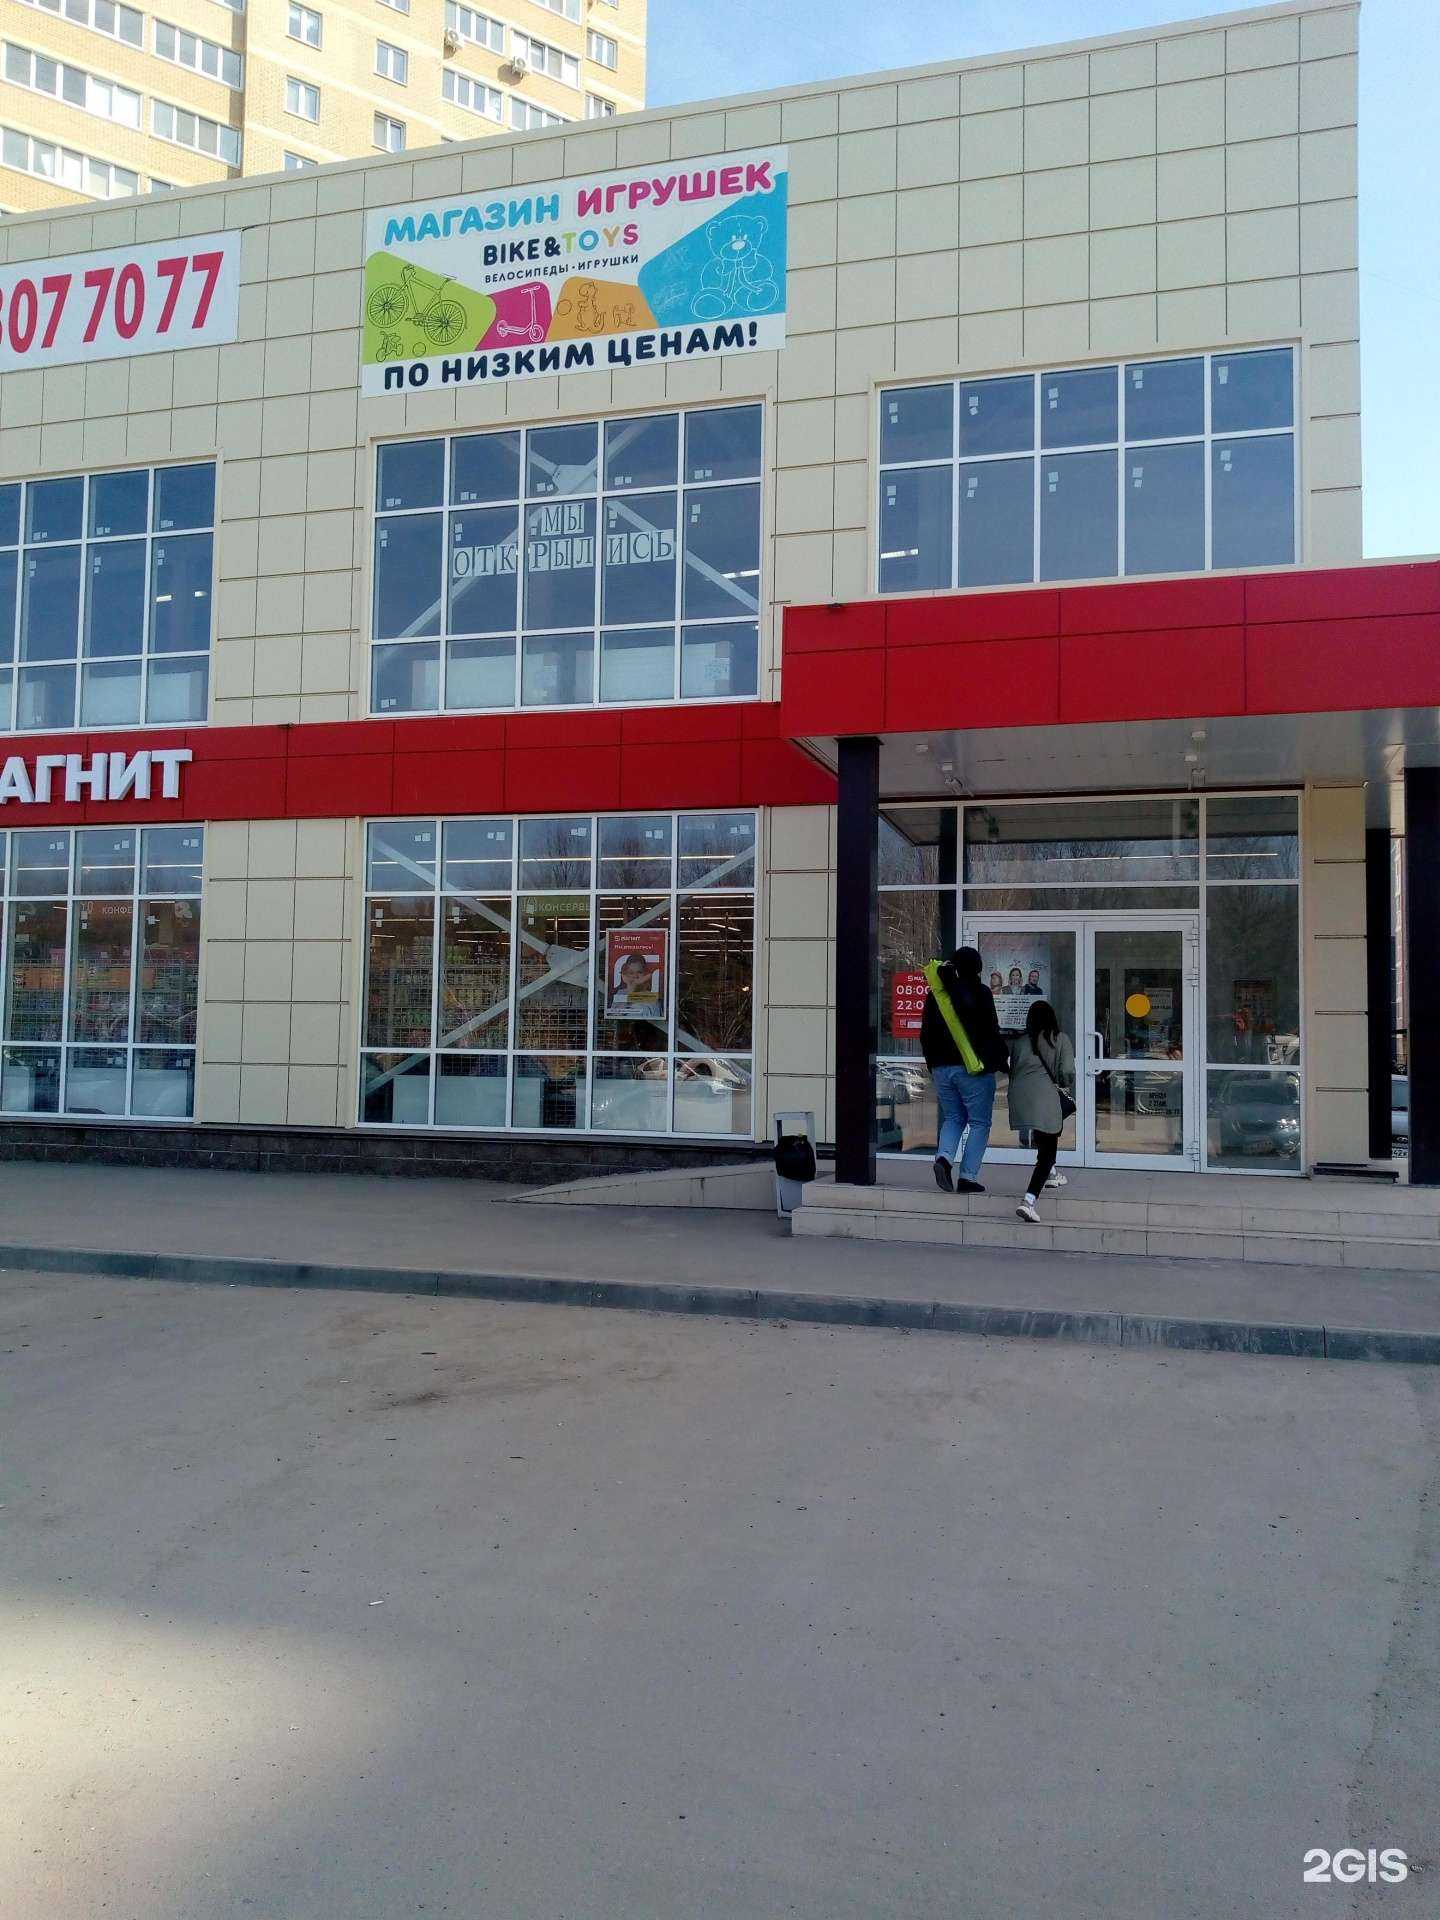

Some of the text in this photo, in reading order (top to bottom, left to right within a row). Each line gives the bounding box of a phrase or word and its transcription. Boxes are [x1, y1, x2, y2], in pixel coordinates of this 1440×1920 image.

[384, 161, 772, 246] МАГАЗИН ИГРУШЕК
[483, 223, 639, 266] BIKE&TOYS
[484, 254, 639, 284] ВЕЛОСИПЕДЫ ИГРУШКИ
[0, 251, 224, 354] 07 70 77
[384, 320, 758, 391] ПО НИЗКИМ ЦЕНАМ!
[544, 504, 582, 533] МЫ
[454, 531, 673, 576] ОТКРЫЛИСЬ
